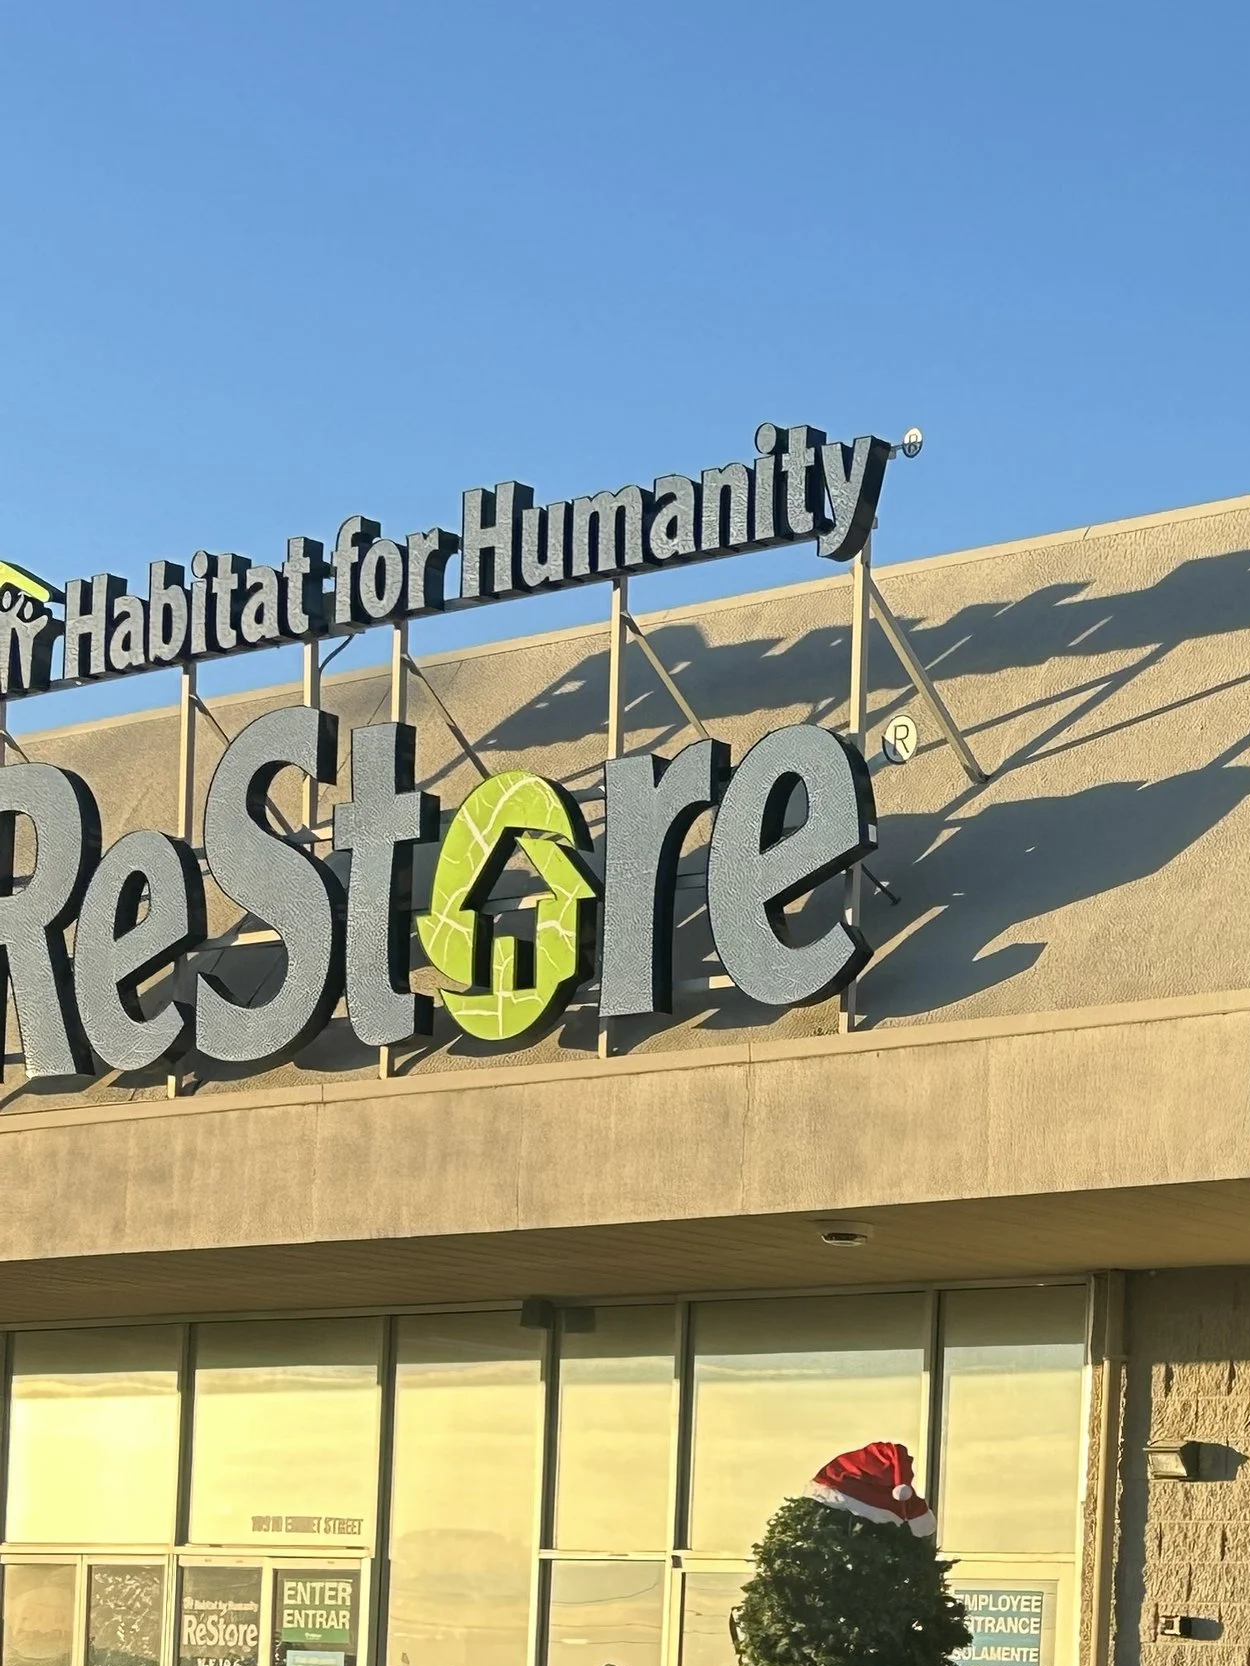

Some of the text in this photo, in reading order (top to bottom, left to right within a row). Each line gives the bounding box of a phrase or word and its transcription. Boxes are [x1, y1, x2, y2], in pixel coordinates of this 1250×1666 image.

[64, 536, 323, 680] Habitat
[332, 515, 458, 625] for
[460, 422, 891, 600] Humanity
[0, 704, 878, 1078] ReStore
[324, 1517, 364, 1535] STREET
[283, 1581, 352, 1605] ENTER
[183, 1612, 258, 1647] ReStore
[282, 1609, 350, 1630] ENTRAR
[964, 1615, 1041, 1634] NTRANCE
[951, 1646, 1039, 1662] SOLAMENTE
